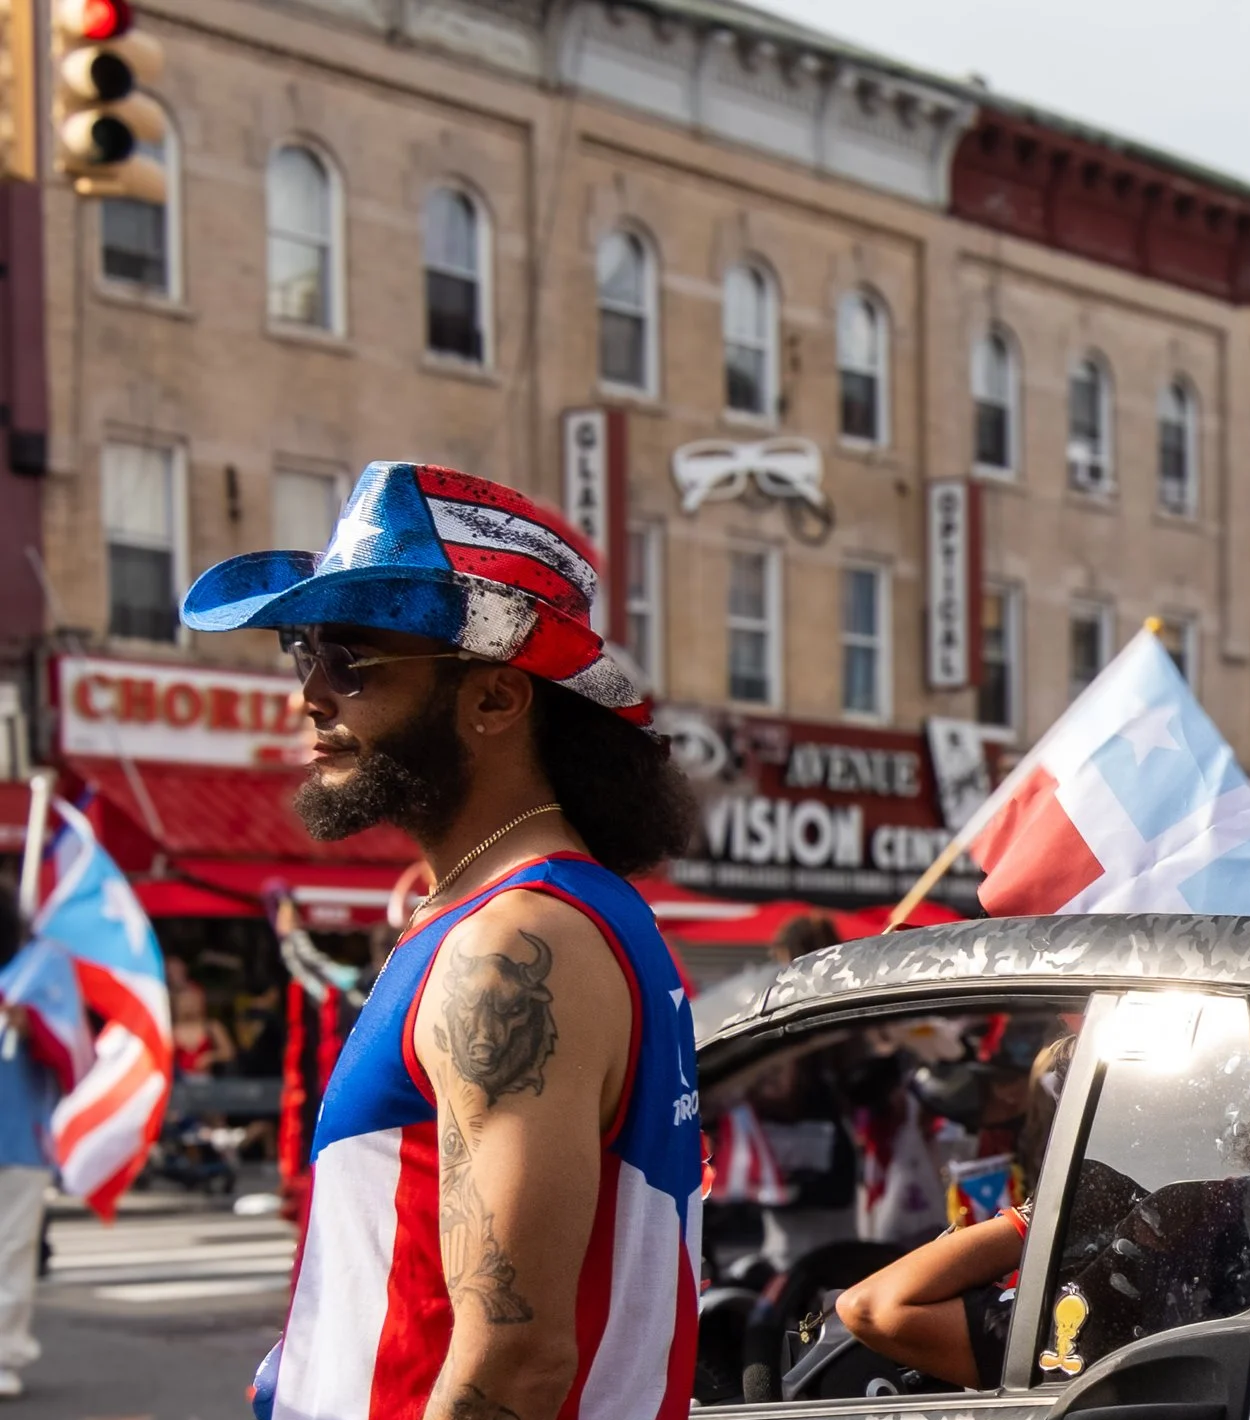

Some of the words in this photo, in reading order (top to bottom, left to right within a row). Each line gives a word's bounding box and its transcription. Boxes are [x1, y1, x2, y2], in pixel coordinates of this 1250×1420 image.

[938, 492, 959, 678] OPTICAL
[785, 742, 921, 797] AVENUE
[706, 797, 863, 866] VISION
